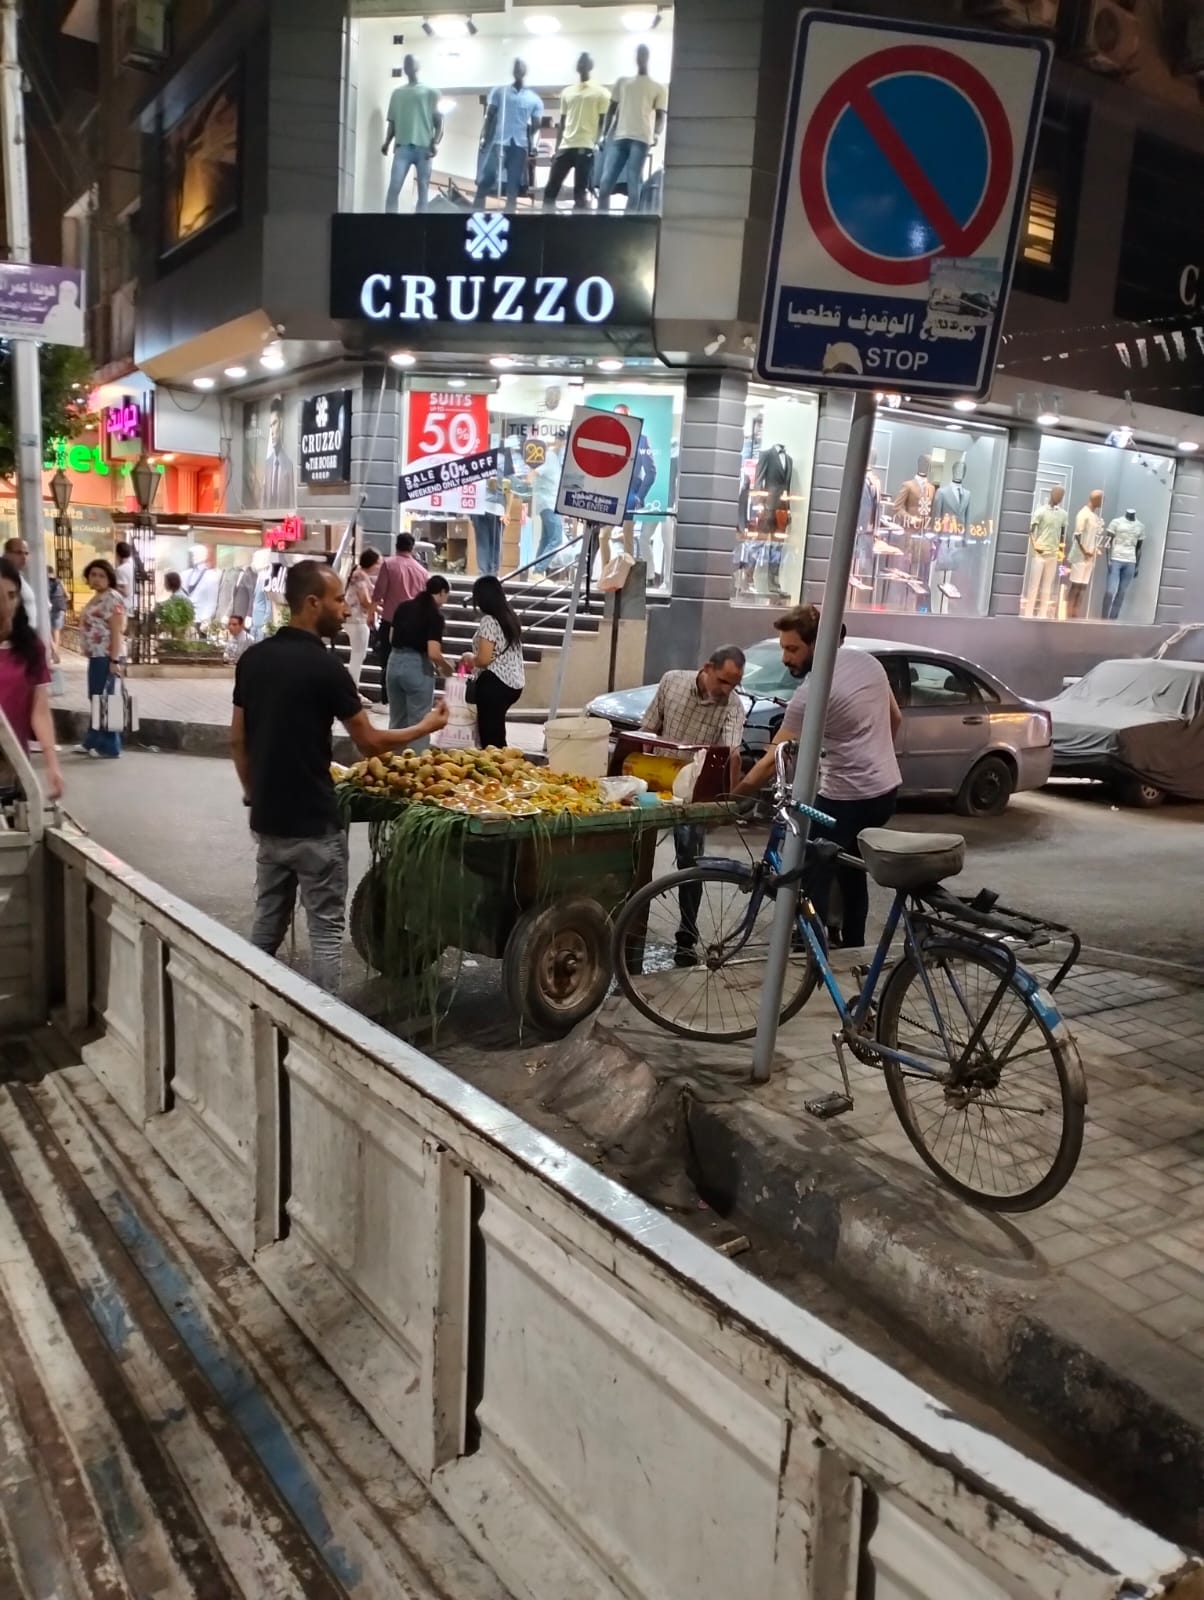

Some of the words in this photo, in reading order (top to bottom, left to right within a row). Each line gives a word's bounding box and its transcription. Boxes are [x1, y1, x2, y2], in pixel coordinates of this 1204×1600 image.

[360, 273, 615, 323] CRUZZO
[787, 301, 842, 329] قطعيا
[847, 308, 915, 337] الوقوف
[866, 347, 929, 371] STOP
[429, 392, 472, 407] SUITS
[301, 430, 341, 454] CRUZZO
[531, 424, 570, 437] HOUS
[404, 470, 435, 486] SALE
[440, 461, 469, 481] 60%
[471, 456, 493, 471] OFF
[407, 483, 442, 499] WEEKEND
[442, 479, 460, 490] ONLY
[571, 499, 586, 508] NO
[586, 501, 609, 513] ENTER
